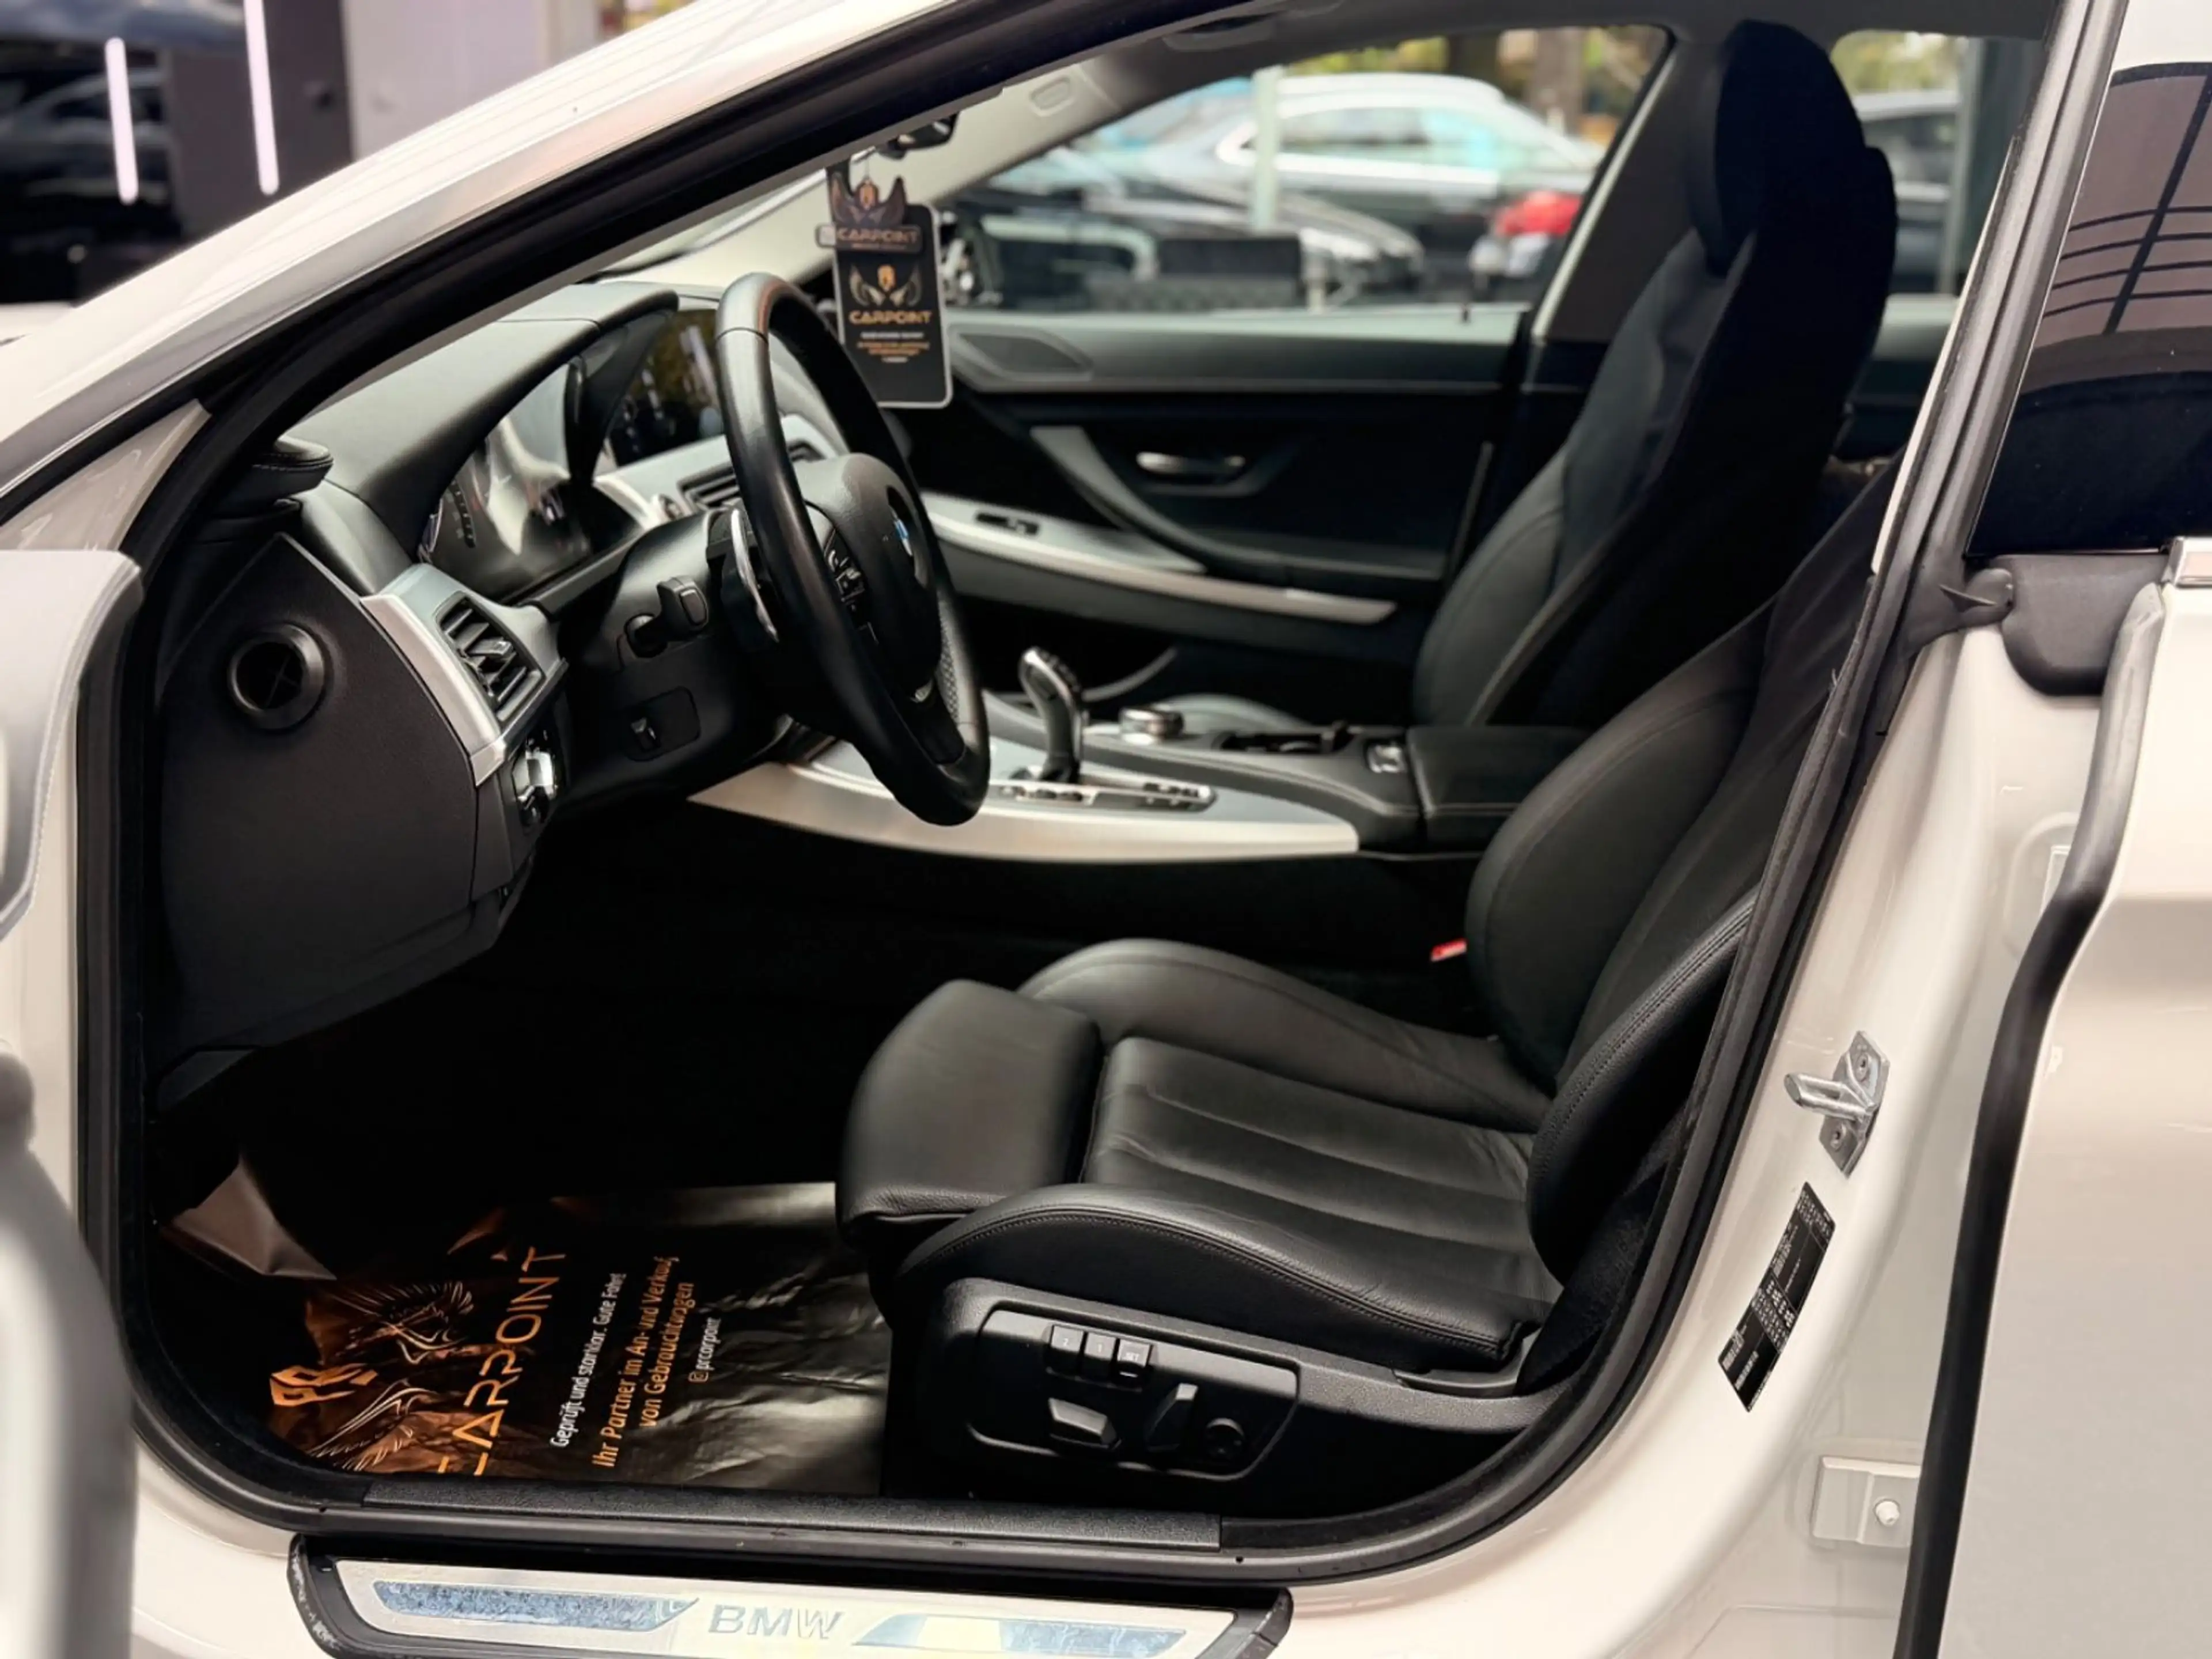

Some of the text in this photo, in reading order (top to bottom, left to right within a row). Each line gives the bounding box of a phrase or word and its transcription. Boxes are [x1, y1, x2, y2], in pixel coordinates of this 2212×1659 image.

[849, 310, 931, 324] CARPOINT
[550, 1400, 586, 1448] Geprüft
[571, 1376, 591, 1400] und
[593, 1298, 618, 1326] Gute
[592, 1255, 681, 1468] Ihr Partner im An- und Verkauf
[639, 1282, 697, 1429] von Gebrauchtwagen
[708, 1604, 845, 1641] BMW
